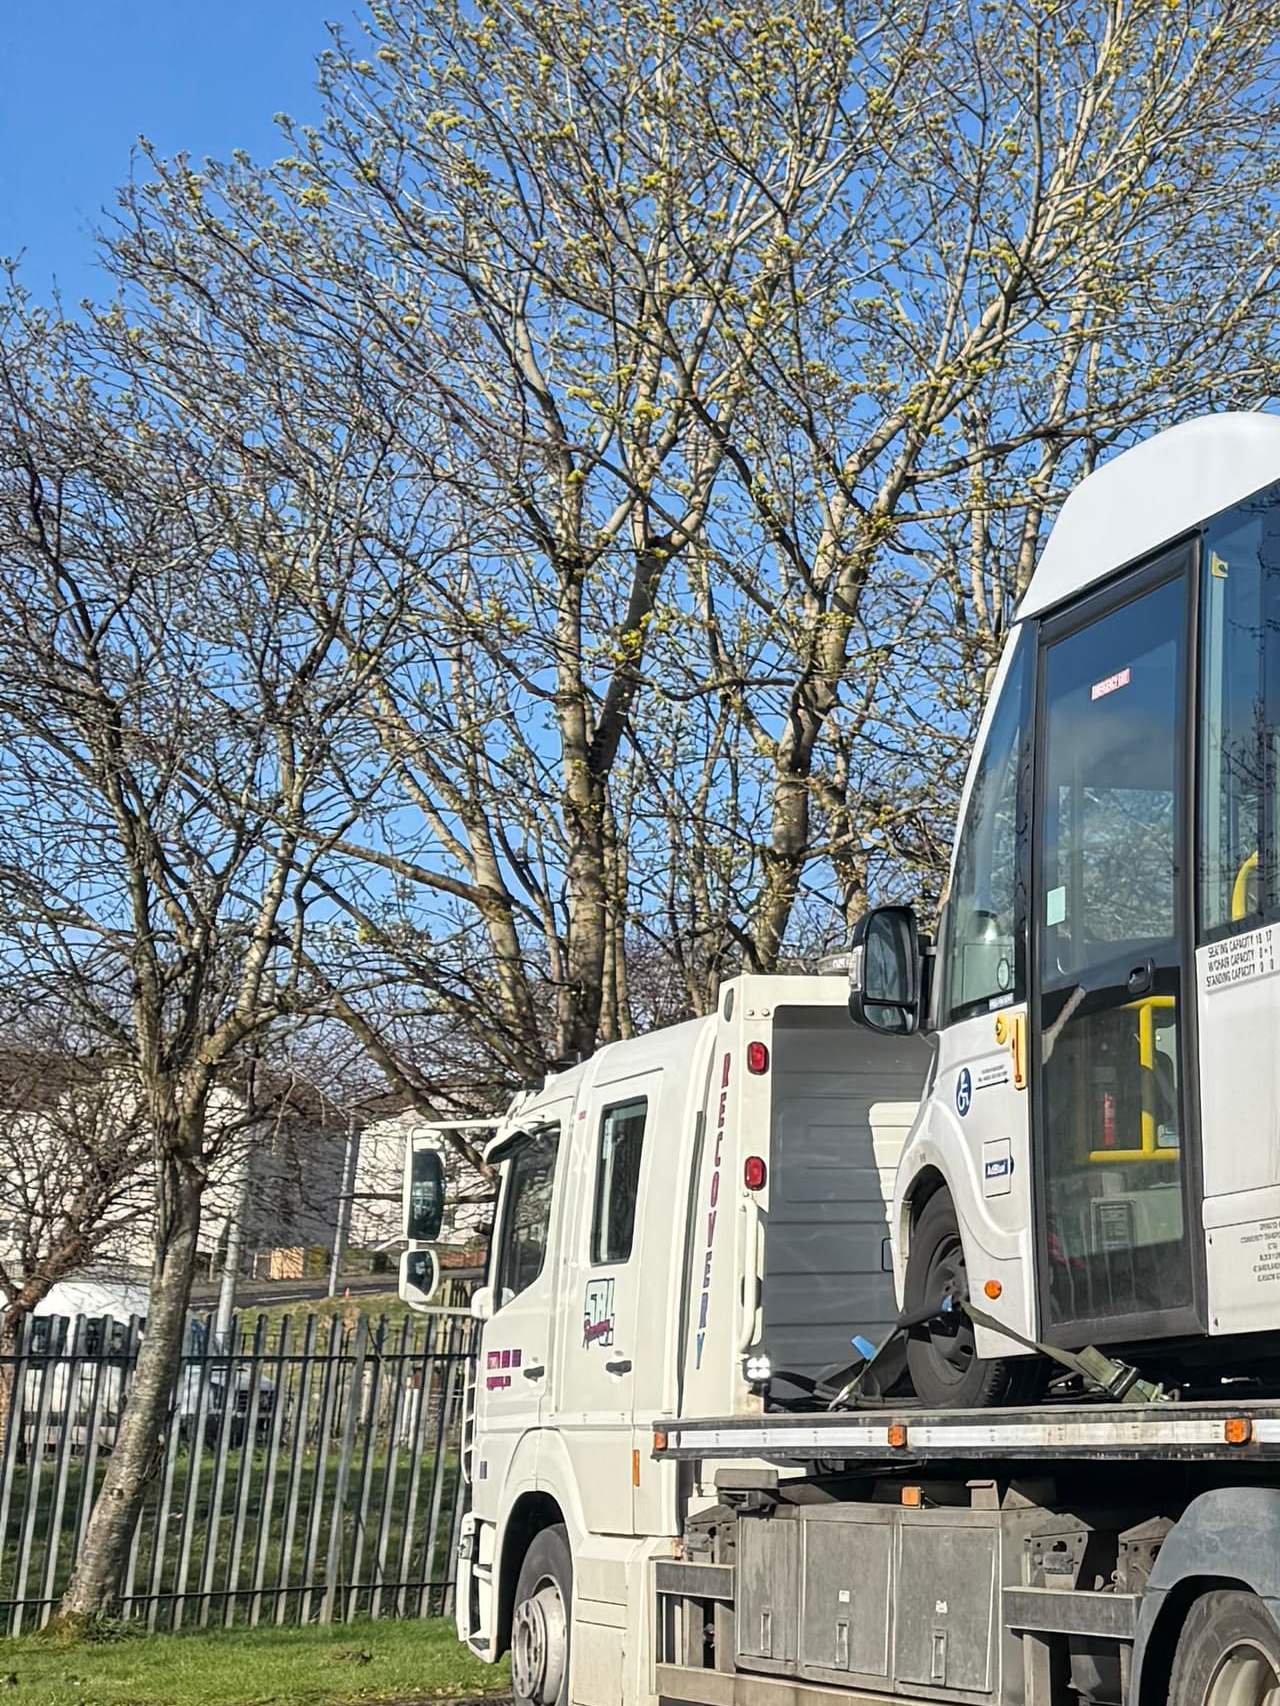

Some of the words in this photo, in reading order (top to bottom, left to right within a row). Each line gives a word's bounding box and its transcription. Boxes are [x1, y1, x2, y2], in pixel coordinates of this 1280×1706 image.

[1229, 935, 1253, 952] CAPACITY
[1231, 949, 1255, 965] CAPACITY
[1206, 971, 1231, 987] STANDING
[1232, 964, 1256, 980] CAPACITY
[696, 1052, 731, 1370] RECOVERY
